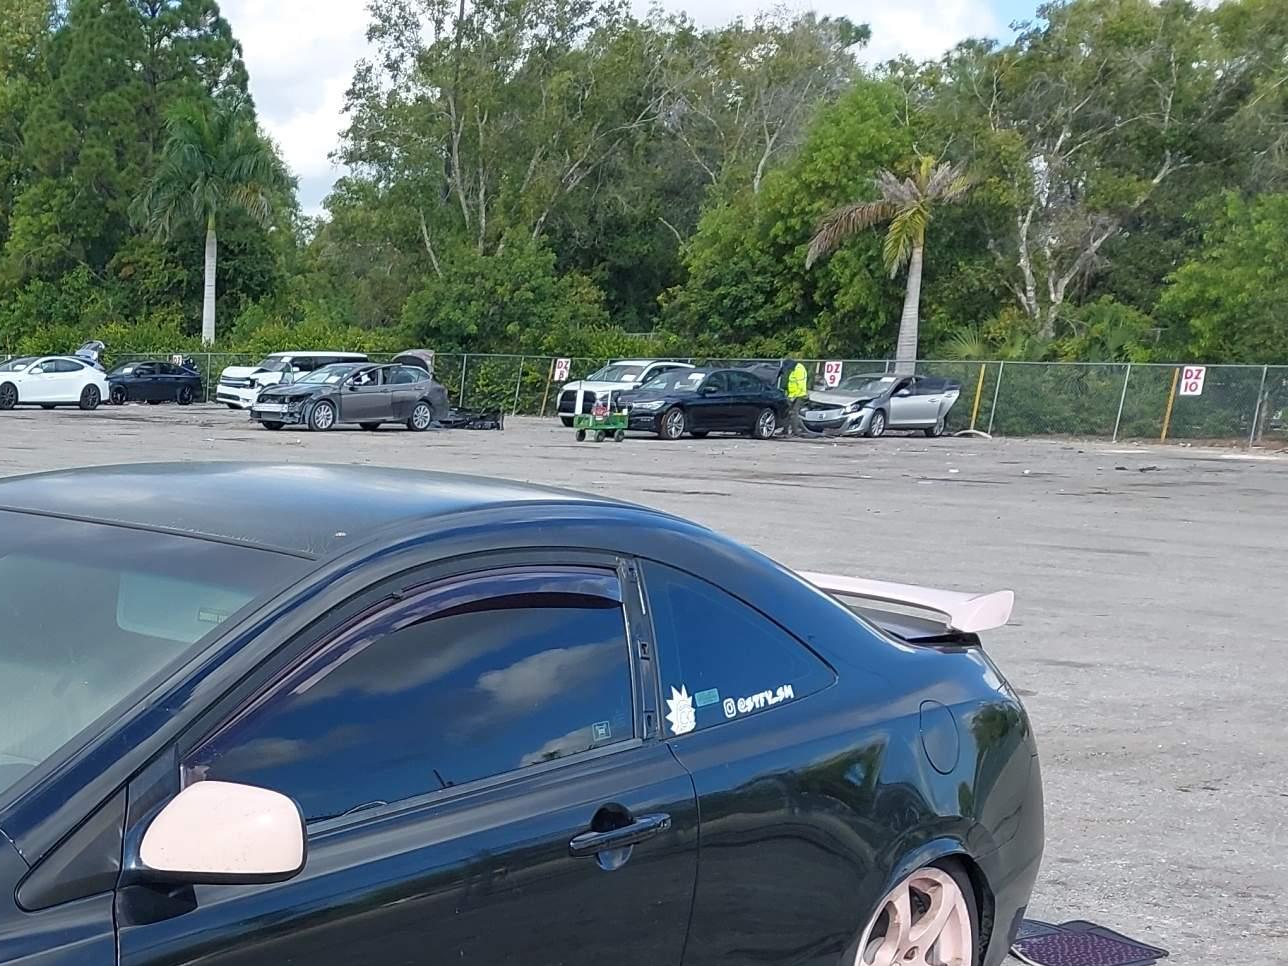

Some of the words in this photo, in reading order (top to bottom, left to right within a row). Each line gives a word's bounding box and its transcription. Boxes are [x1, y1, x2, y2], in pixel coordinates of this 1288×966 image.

[557, 361, 568, 369] DZ
[826, 363, 840, 373] DZ
[1184, 368, 1203, 379] DZ
[829, 374, 836, 384] 9
[1184, 381, 1198, 392] 10
